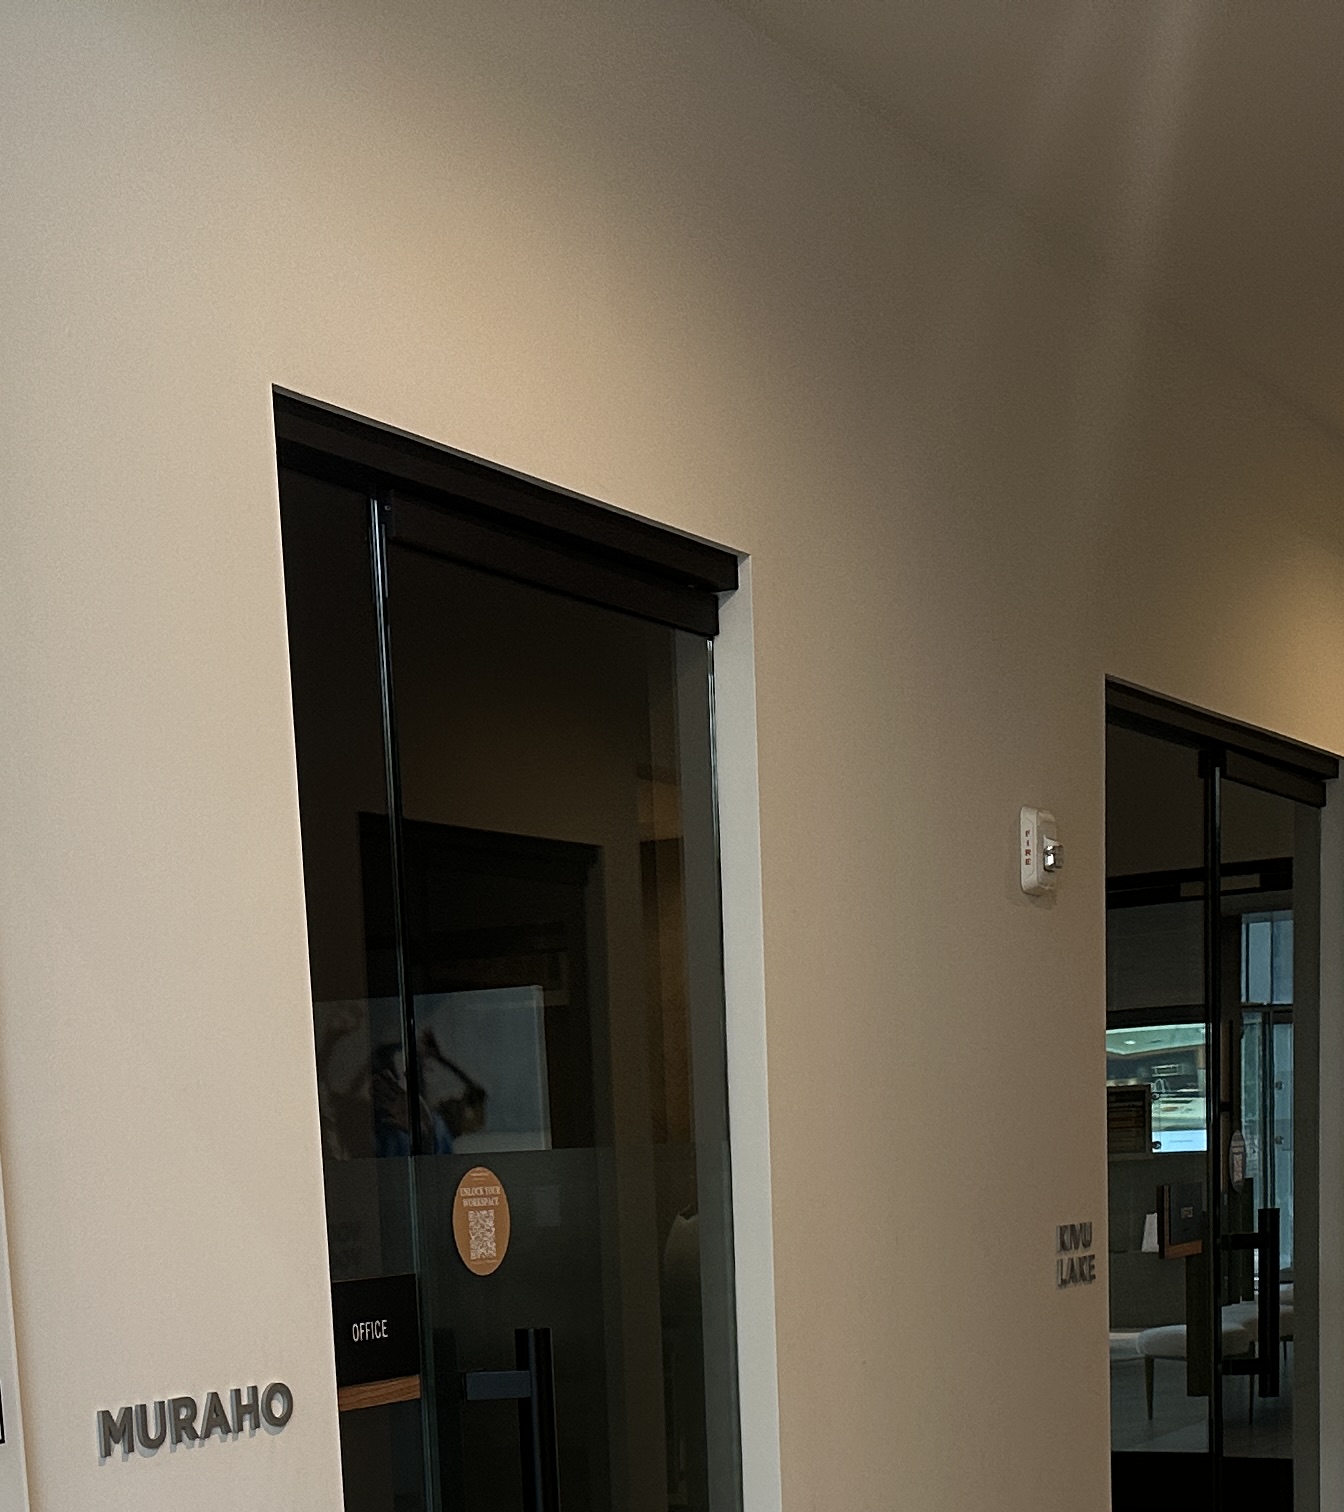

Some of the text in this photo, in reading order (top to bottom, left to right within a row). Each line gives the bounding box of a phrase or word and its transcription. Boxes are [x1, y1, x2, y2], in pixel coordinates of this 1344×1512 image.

[1024, 829, 1032, 866] FIRE
[1056, 1254, 1097, 1288] LAKE
[352, 1319, 389, 1342] OFFICE
[97, 1382, 294, 1460] MURAHO
